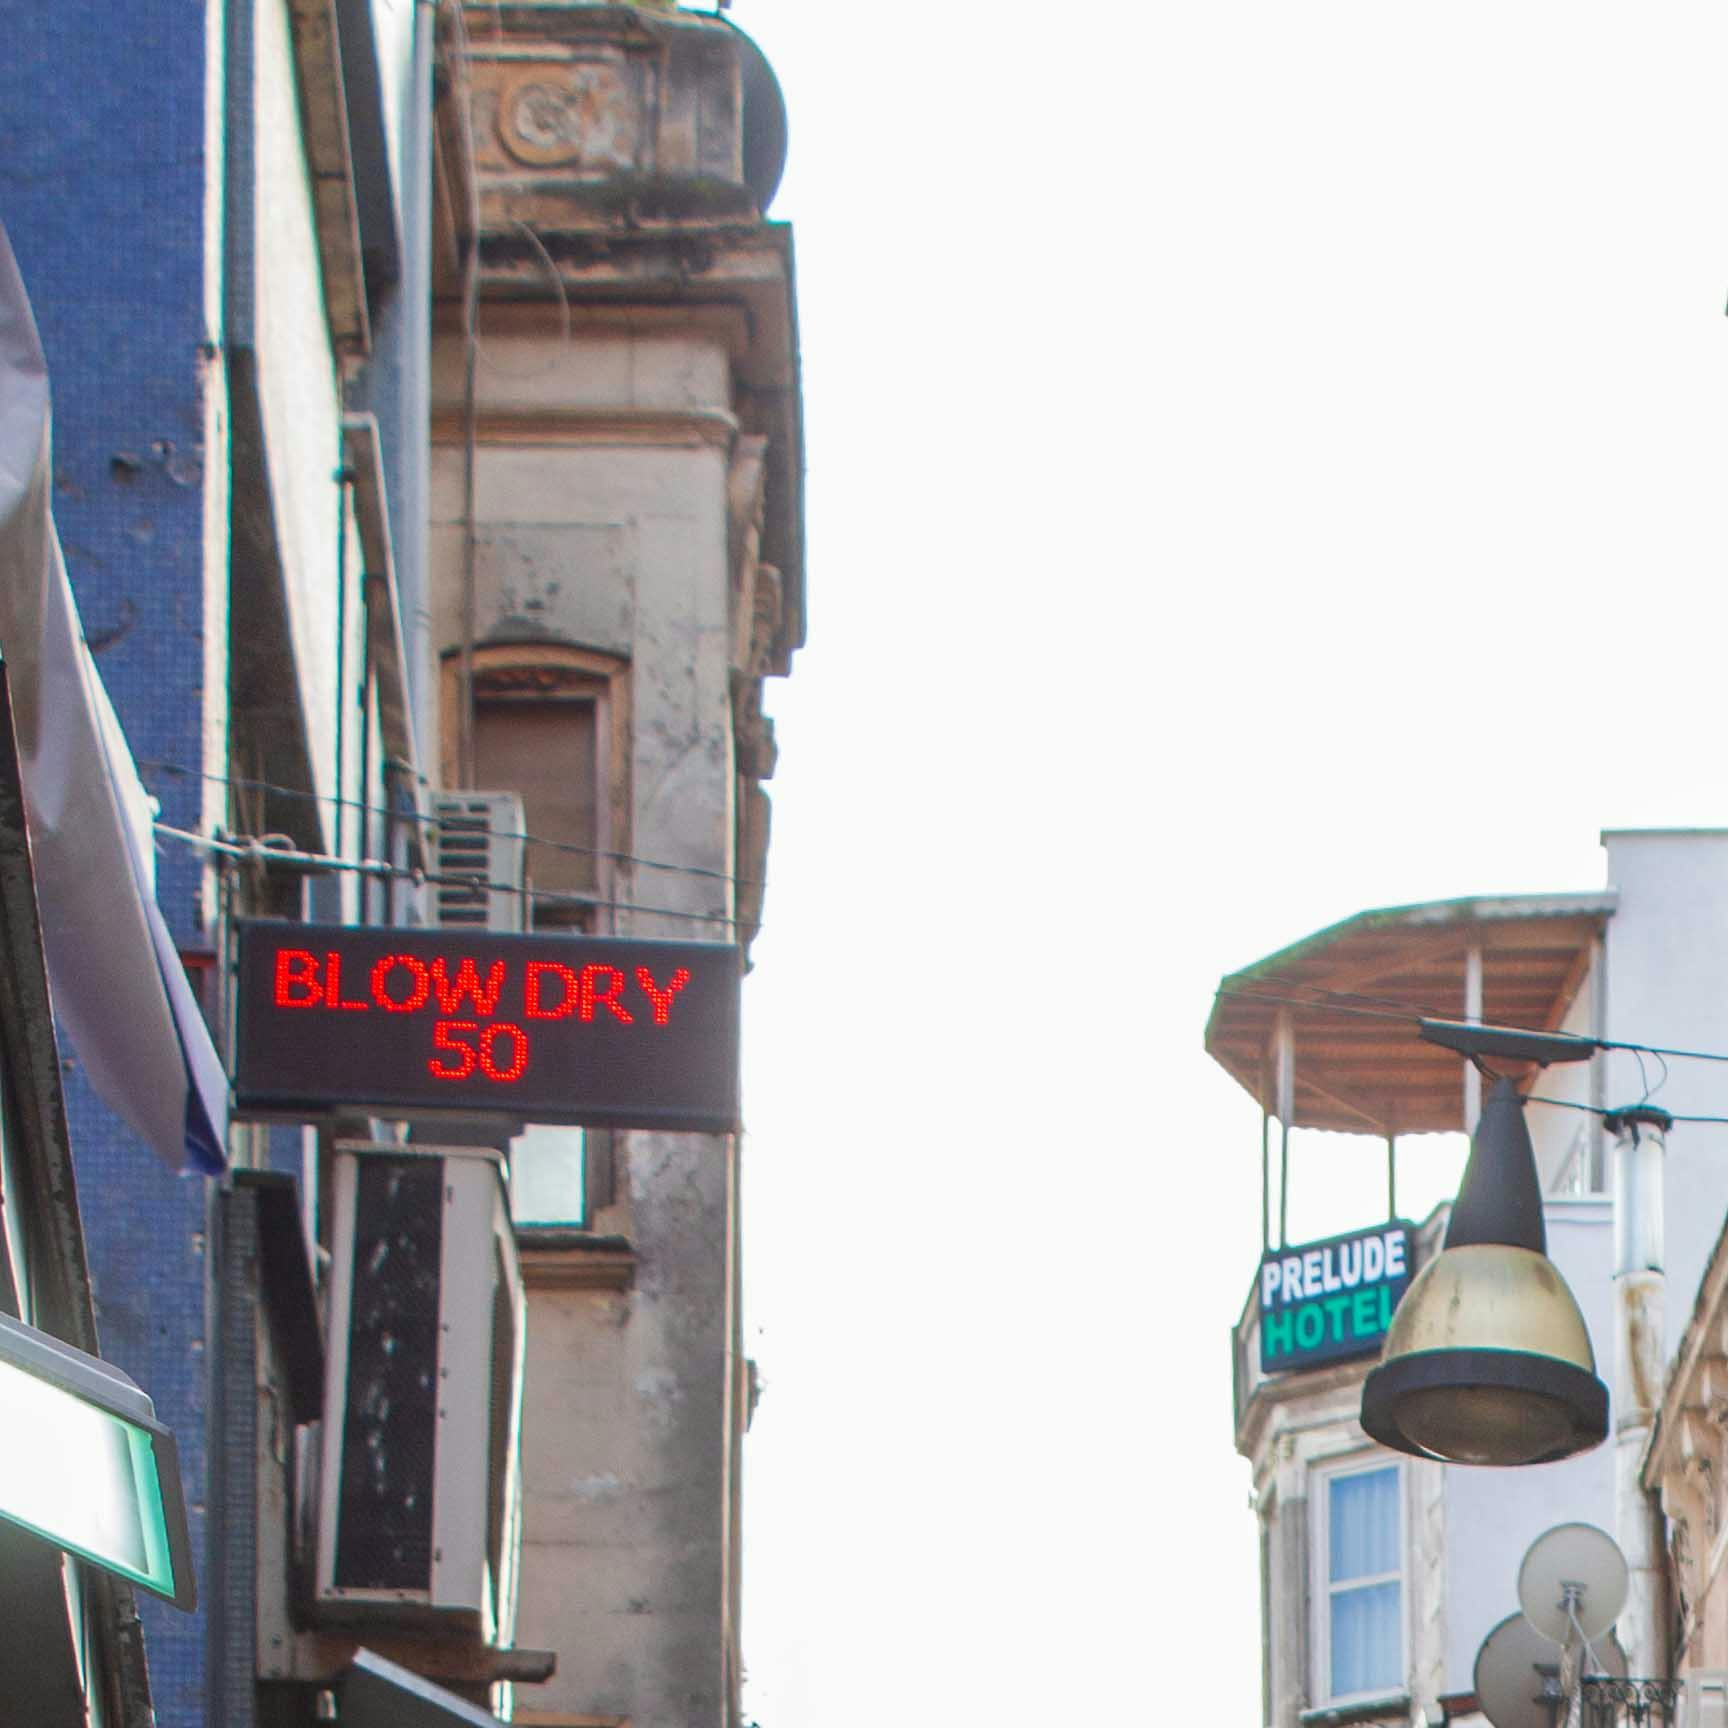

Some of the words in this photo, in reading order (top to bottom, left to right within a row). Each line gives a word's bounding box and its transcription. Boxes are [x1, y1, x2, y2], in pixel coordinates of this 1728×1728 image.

[274, 948, 506, 1016] BLOW
[524, 960, 691, 1025] DRY
[428, 1021, 530, 1082] 50
[1262, 1230, 1406, 1306] PRELUDE
[1264, 1285, 1392, 1358] HOTEL
